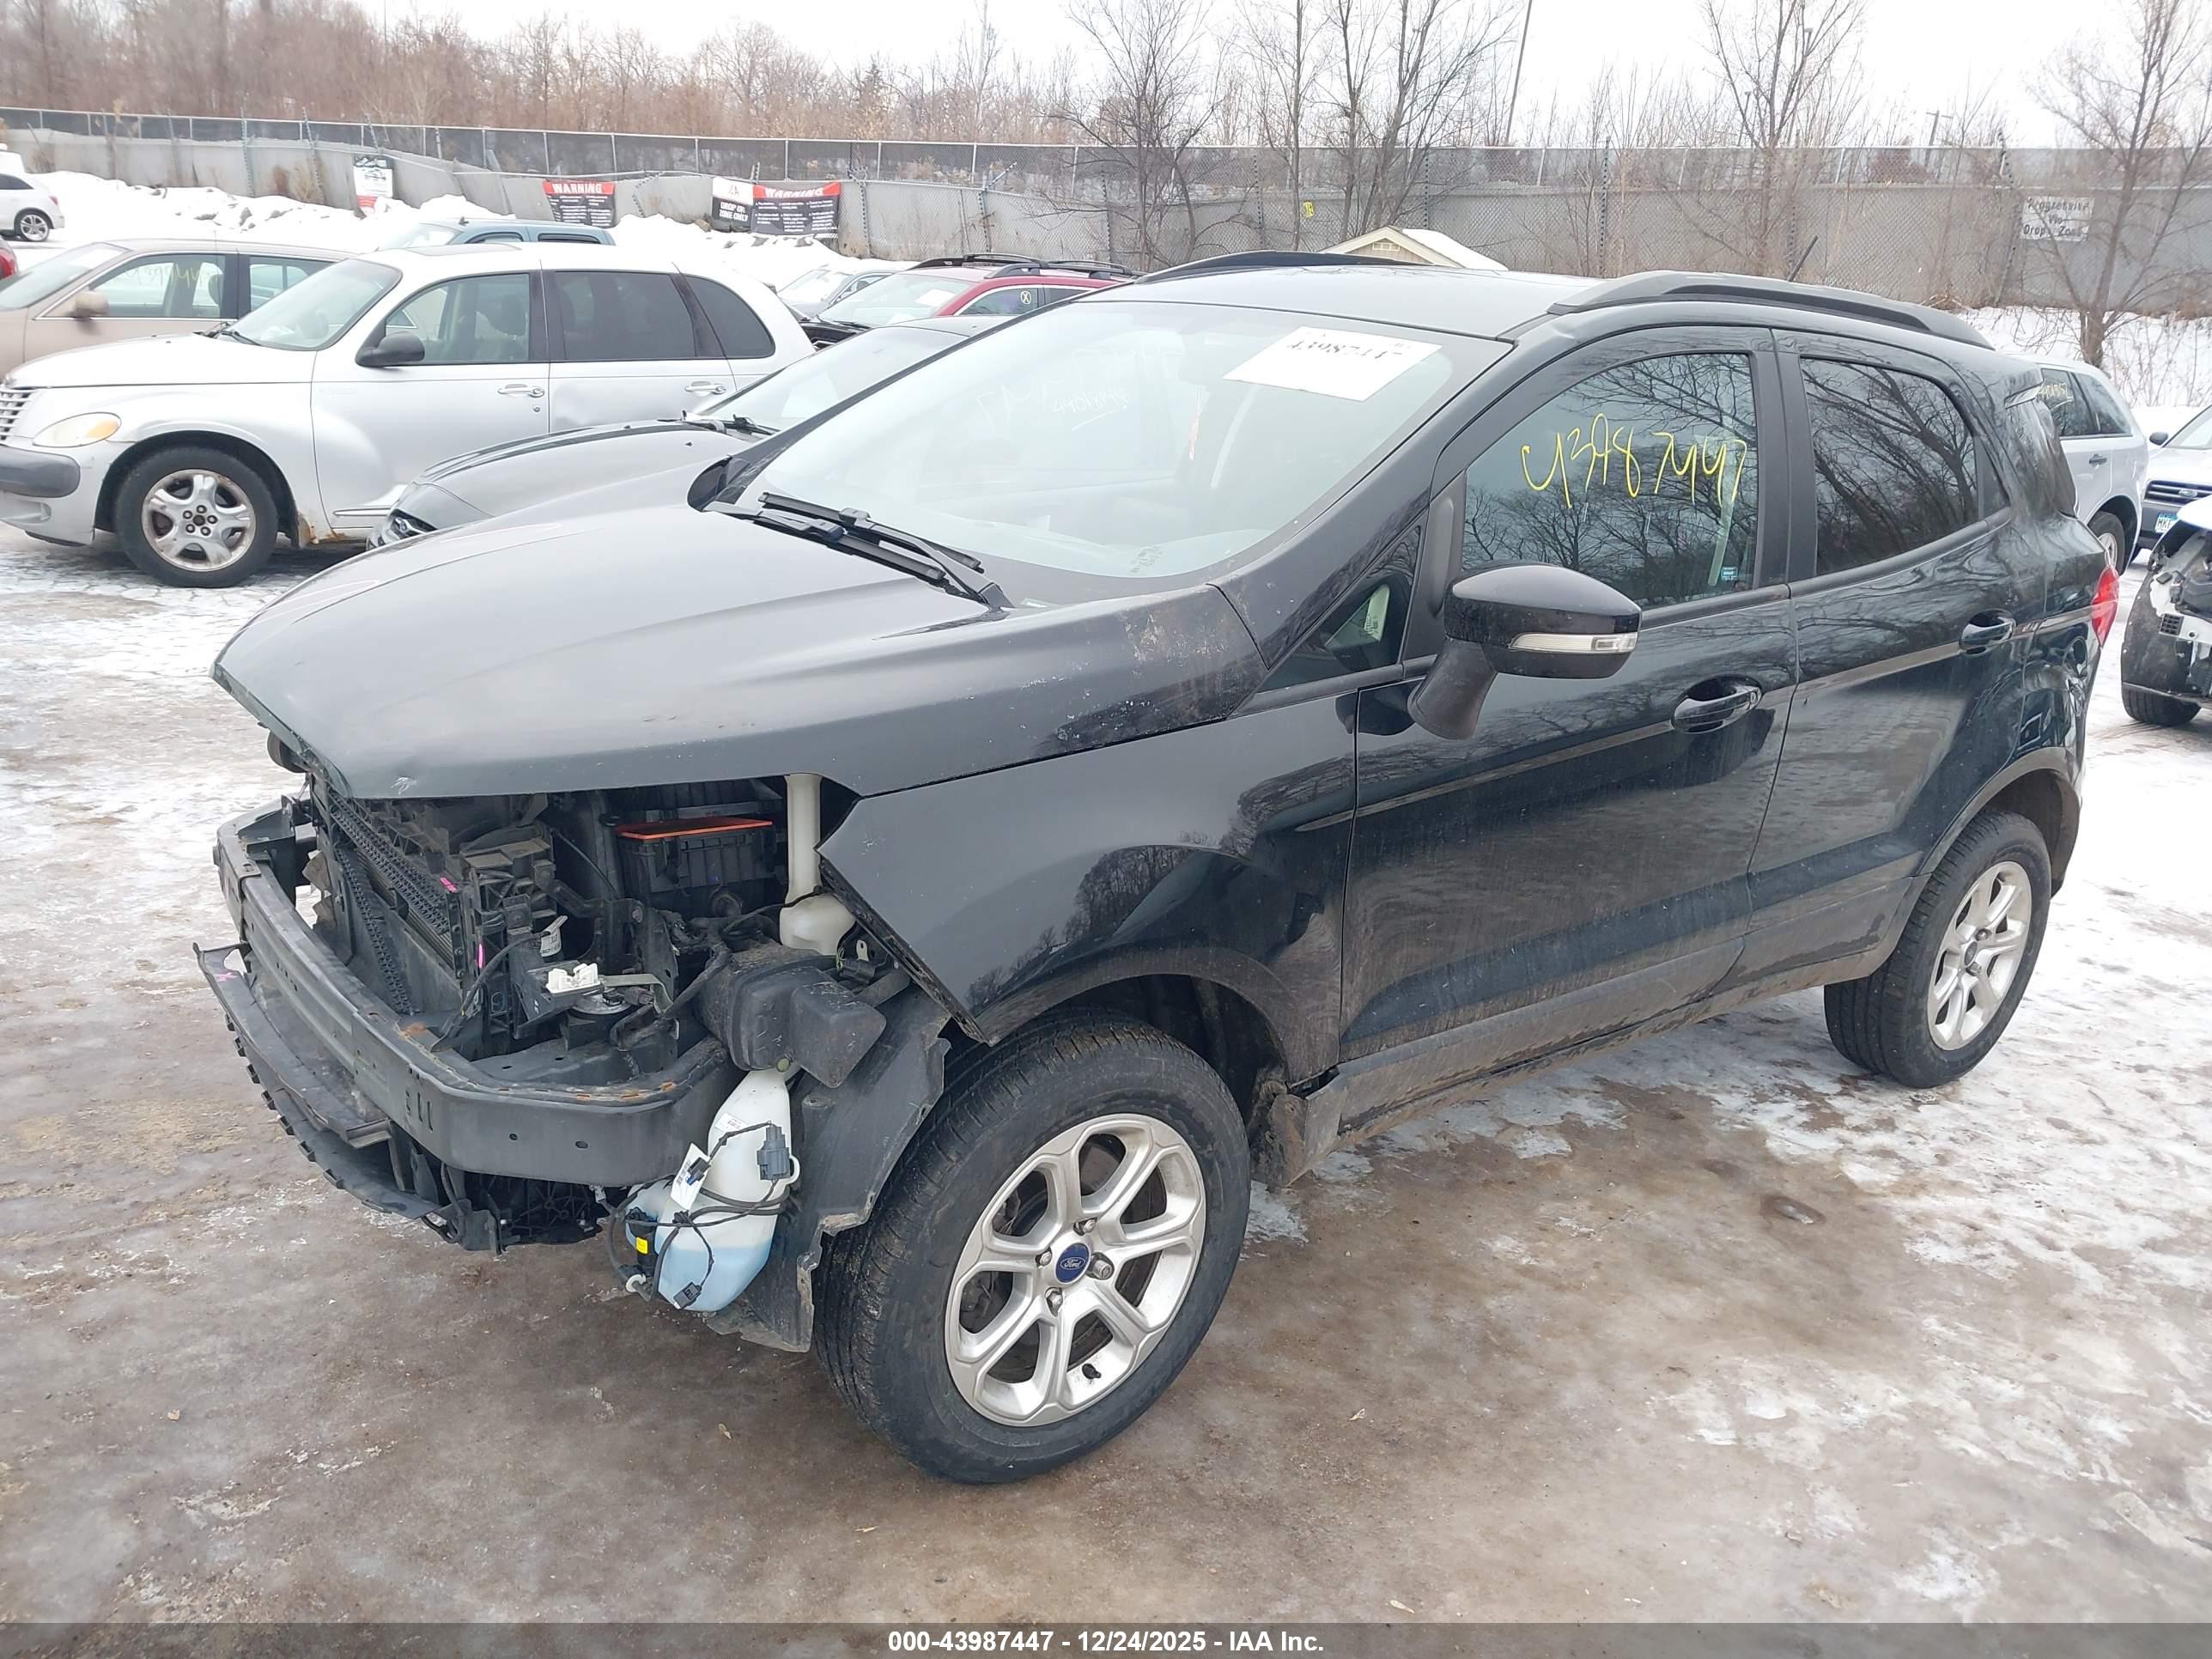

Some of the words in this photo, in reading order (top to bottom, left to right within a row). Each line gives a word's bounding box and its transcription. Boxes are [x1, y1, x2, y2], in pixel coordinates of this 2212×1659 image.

[551, 183, 603, 194] WARNING
[763, 186, 824, 198] WARNING
[2023, 224, 2045, 238] Drop
[1064, 1258, 1082, 1268] Ford
